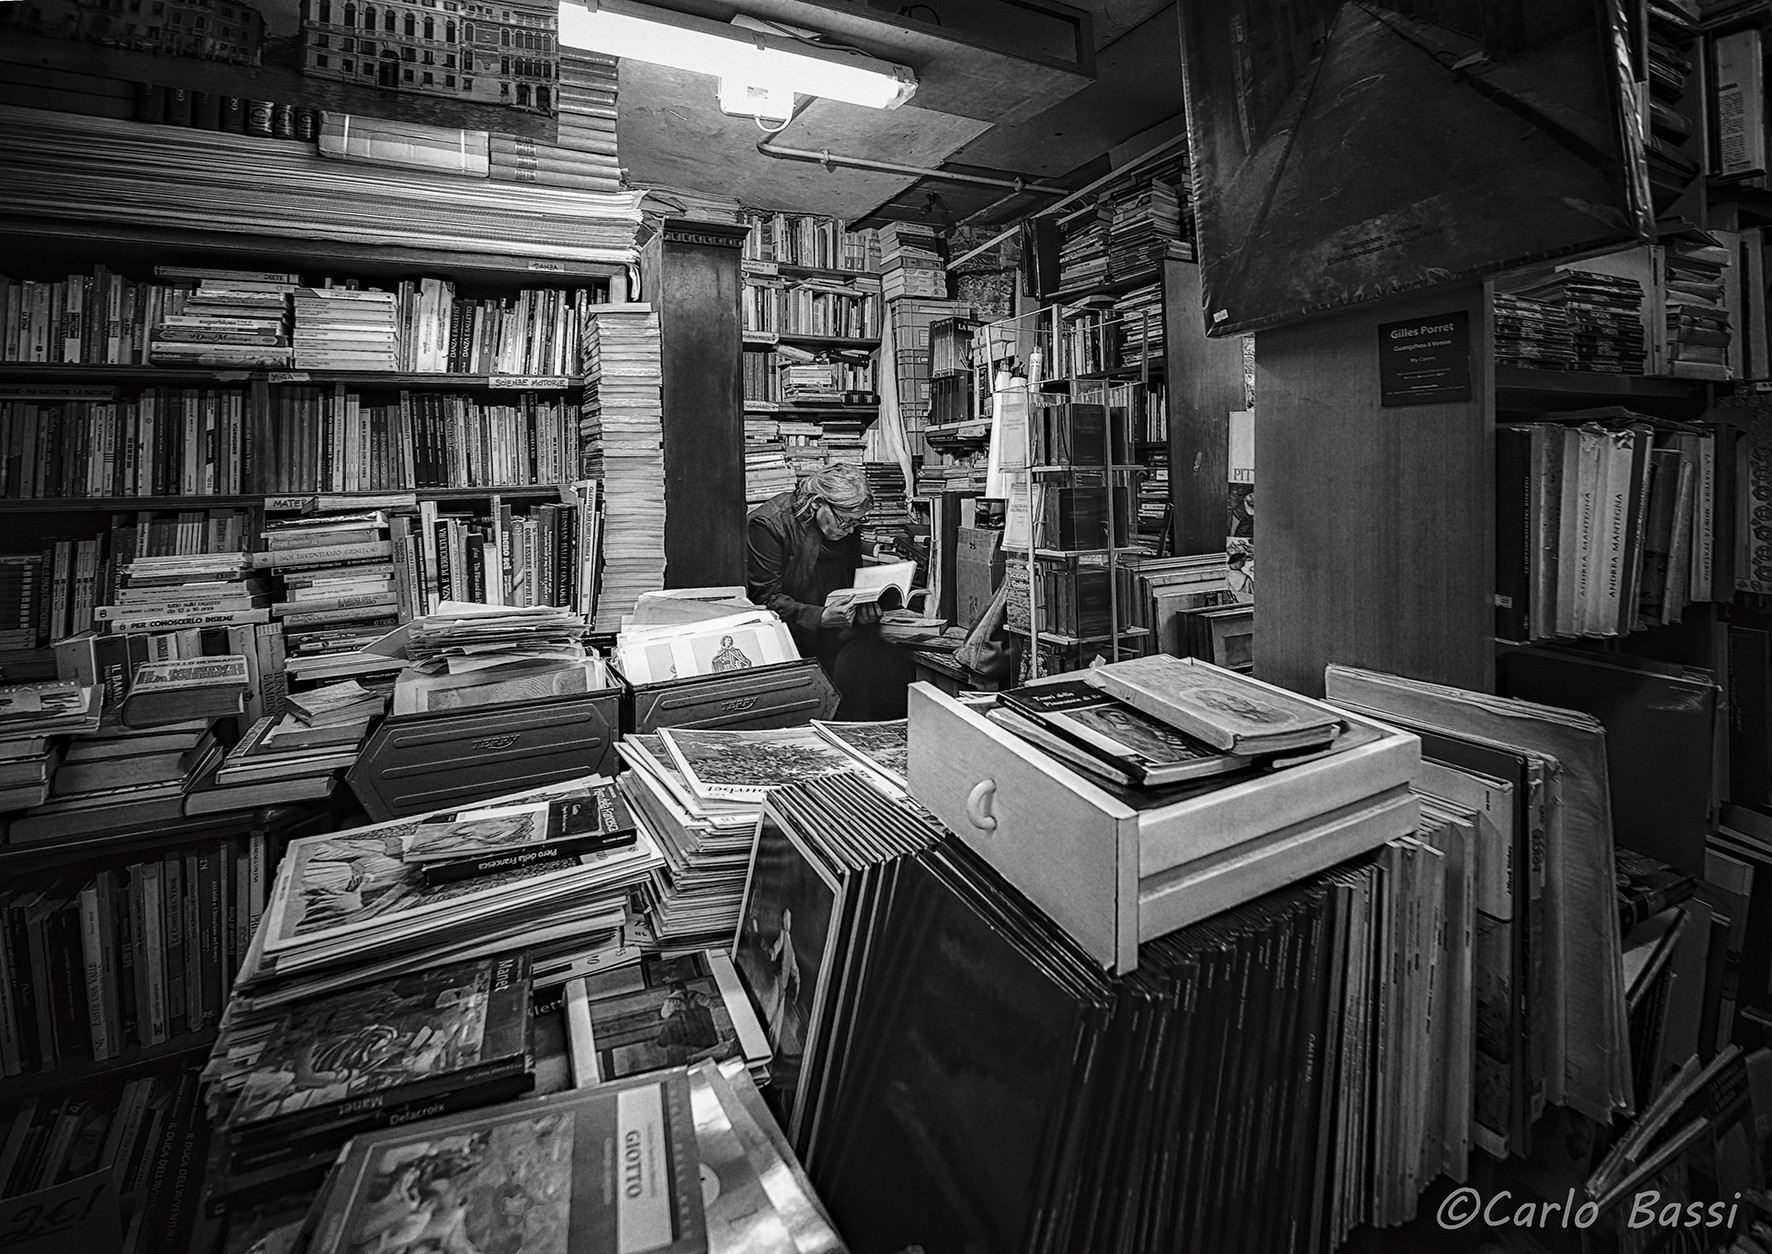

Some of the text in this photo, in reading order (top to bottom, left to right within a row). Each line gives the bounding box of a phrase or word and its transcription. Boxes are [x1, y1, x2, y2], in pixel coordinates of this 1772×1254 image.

[1390, 322, 1455, 339] Gilles Porret
[525, 528, 533, 544] COME
[561, 510, 569, 540] RUSSIAN
[279, 546, 378, 562] NOI DIVENTIAMO GENITORI
[439, 528, 450, 576] PUERICULTURA
[501, 531, 512, 570] meno sei
[560, 543, 569, 569] BALLET
[1608, 493, 1623, 598] ANDREA MANTEGNA
[560, 571, 568, 582] ON
[149, 618, 203, 627] CONOSCERLO
[111, 664, 122, 673] IL
[722, 696, 759, 712] TERRY
[471, 733, 521, 750] TERRY
[477, 848, 558, 870] Piero della Francesca
[87, 962, 98, 985] VALLE
[495, 958, 514, 992] Manet
[90, 986, 100, 1002] UNA
[337, 1095, 384, 1116] Manet
[389, 1103, 446, 1127] Delacroix
[119, 1140, 131, 1163] VOLTO
[129, 1105, 140, 1129] ANIMA
[170, 1122, 178, 1130] IL
[186, 1132, 195, 1140] IL
[162, 1130, 175, 1156] DUCA
[179, 1141, 193, 1167] DUCA
[625, 1130, 642, 1199] GIOTTO
